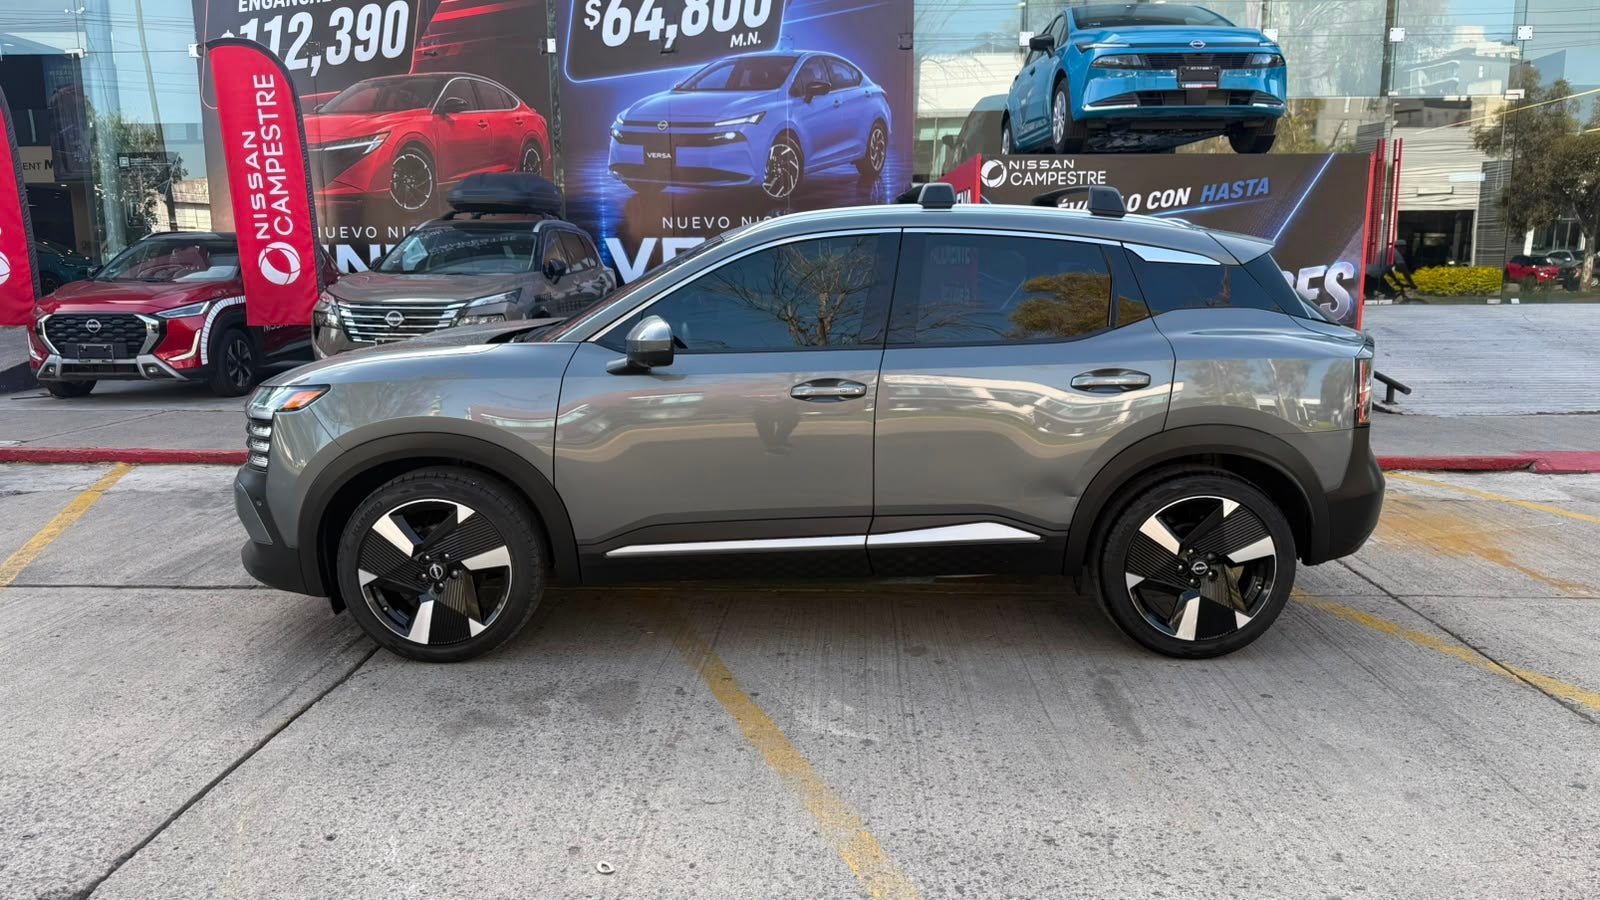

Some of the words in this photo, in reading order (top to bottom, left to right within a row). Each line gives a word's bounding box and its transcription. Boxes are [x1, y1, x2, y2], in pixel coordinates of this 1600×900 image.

[729, 32, 761, 48] M.N.
[252, 73, 294, 236] CAMPESTRE
[646, 151, 672, 159] VERSA
[1008, 159, 1075, 170] NISSAN
[241, 130, 271, 240] NISSAN
[1010, 170, 1107, 186] CAMPESTRE
[1146, 187, 1192, 210] CON
[1200, 176, 1270, 202] HASTA
[662, 216, 730, 229] NUEVO
